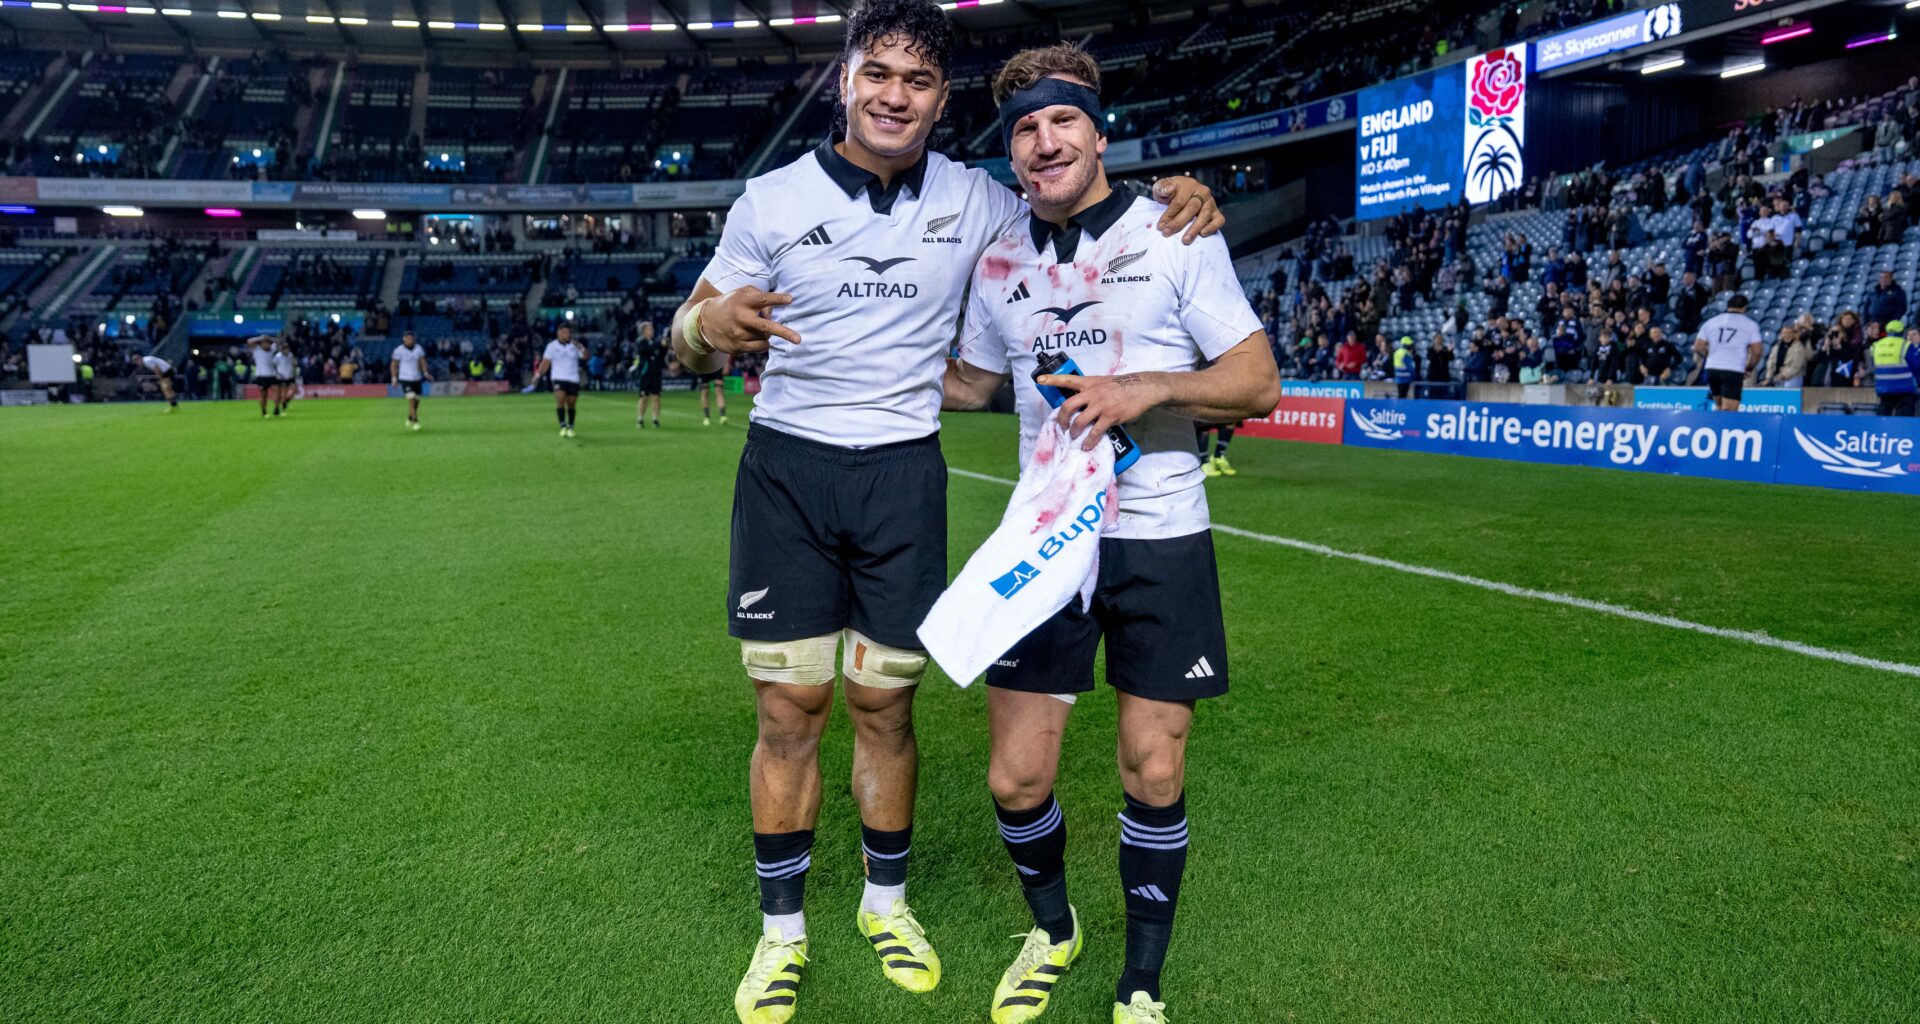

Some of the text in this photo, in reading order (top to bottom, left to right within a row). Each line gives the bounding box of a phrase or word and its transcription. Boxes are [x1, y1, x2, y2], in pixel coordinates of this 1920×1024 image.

[1564, 23, 1639, 56] Skyscanner
[1361, 100, 1434, 137] ENGLAND
[1360, 133, 1398, 160] v FIJI
[1360, 162, 1376, 176] KO
[1360, 174, 1427, 194] Match shown in the
[1360, 194, 1378, 206] West
[1384, 189, 1406, 202] North
[1406, 187, 1420, 199] Fan
[1419, 182, 1450, 198] Villages
[1101, 275, 1151, 285] ALL BLACKS
[837, 282, 918, 299] ALTRAD
[1031, 328, 1107, 353] ALTRAD
[1717, 327, 1738, 344] 17
[1274, 409, 1337, 429] EXPERTS
[1369, 407, 1407, 427] Saltire
[1425, 405, 1763, 466] saltire-energy.com
[1834, 429, 1914, 456] Saltire
[737, 611, 746, 619] ALL
